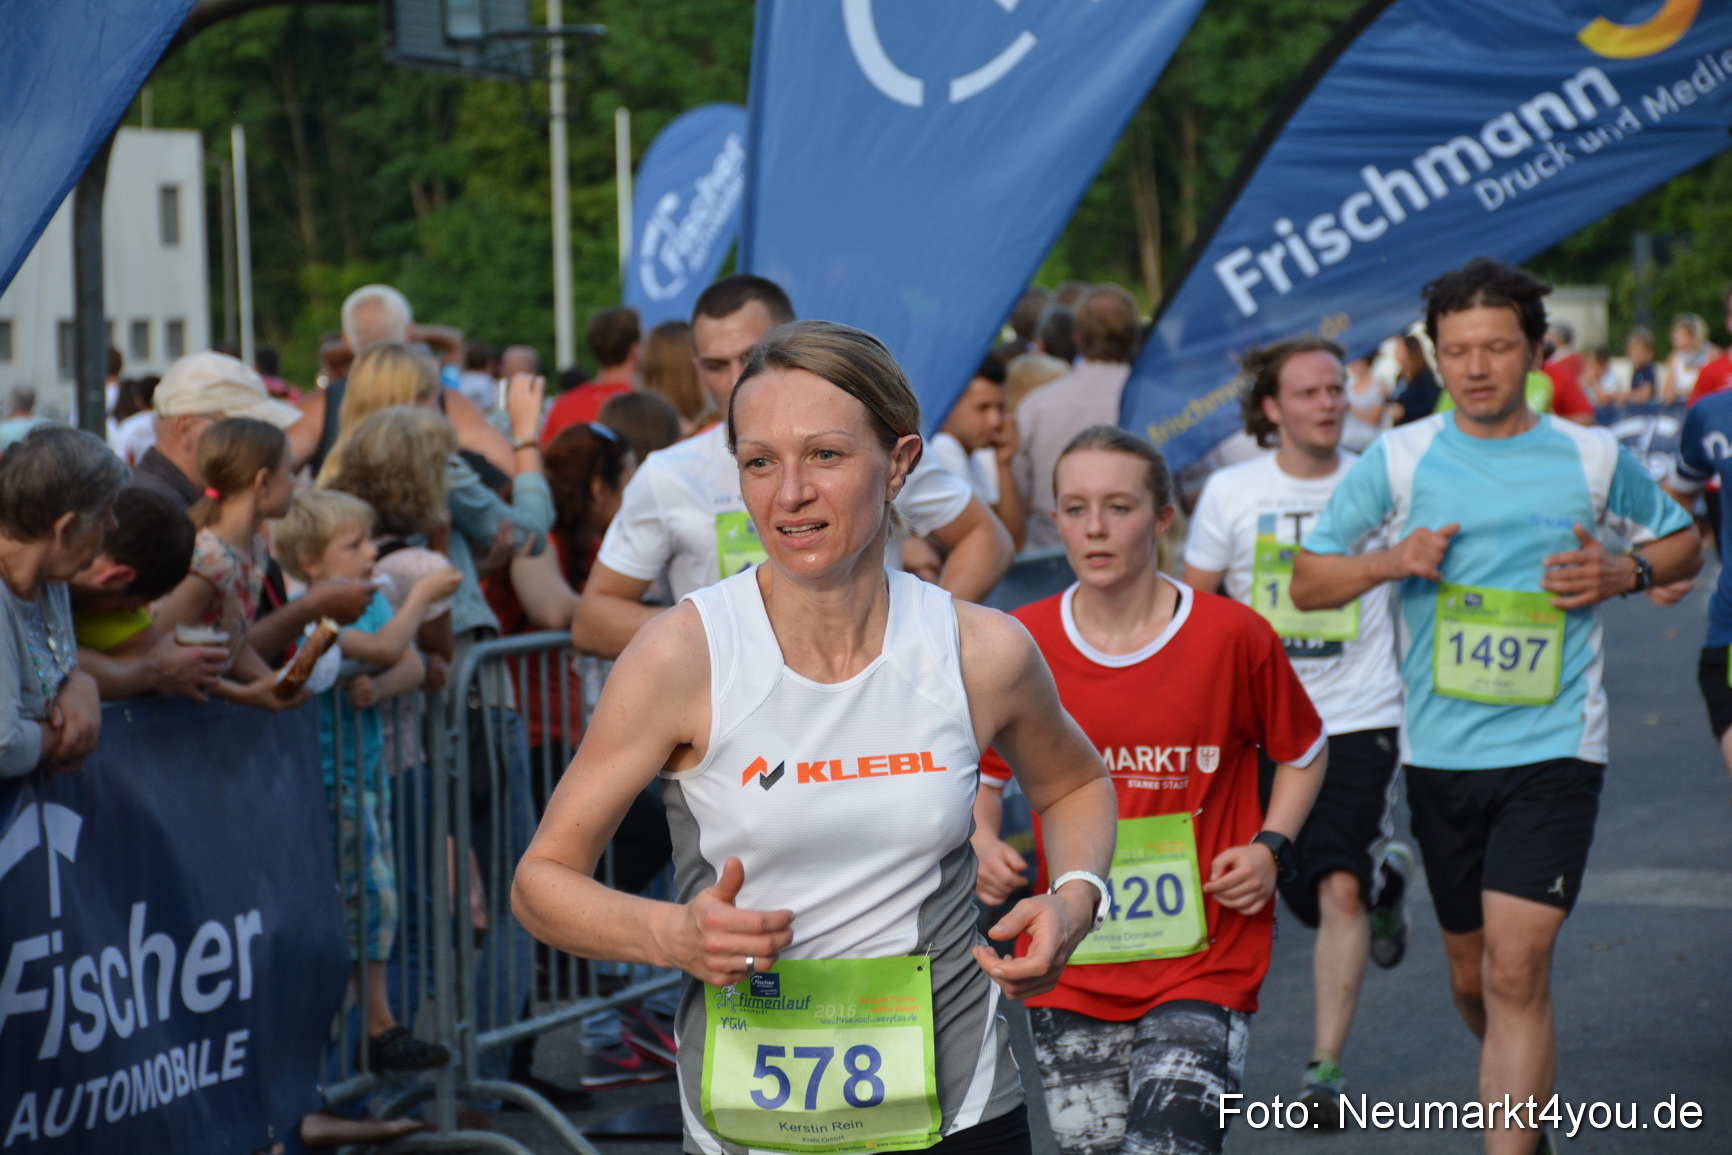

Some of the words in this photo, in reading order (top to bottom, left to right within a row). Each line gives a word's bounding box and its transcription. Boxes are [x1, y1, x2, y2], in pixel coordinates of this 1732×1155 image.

[1473, 141, 1575, 211] Druck
[1577, 105, 1642, 153] und
[1213, 66, 1621, 317] Frischmann
[1449, 629, 1549, 673] 1497
[797, 751, 947, 784] KLEBL
[1128, 779, 1160, 790] STARKE
[1162, 780, 1188, 790] STADT
[0, 901, 263, 1060] Fischer
[739, 993, 812, 1010] firmenlauf
[815, 1004, 857, 1018] 2016
[3, 1029, 249, 1148] AUTOMOBILE
[750, 1044, 885, 1110] 578
[779, 1122, 828, 1134] Kerstin
[832, 1120, 864, 1131] Rein
